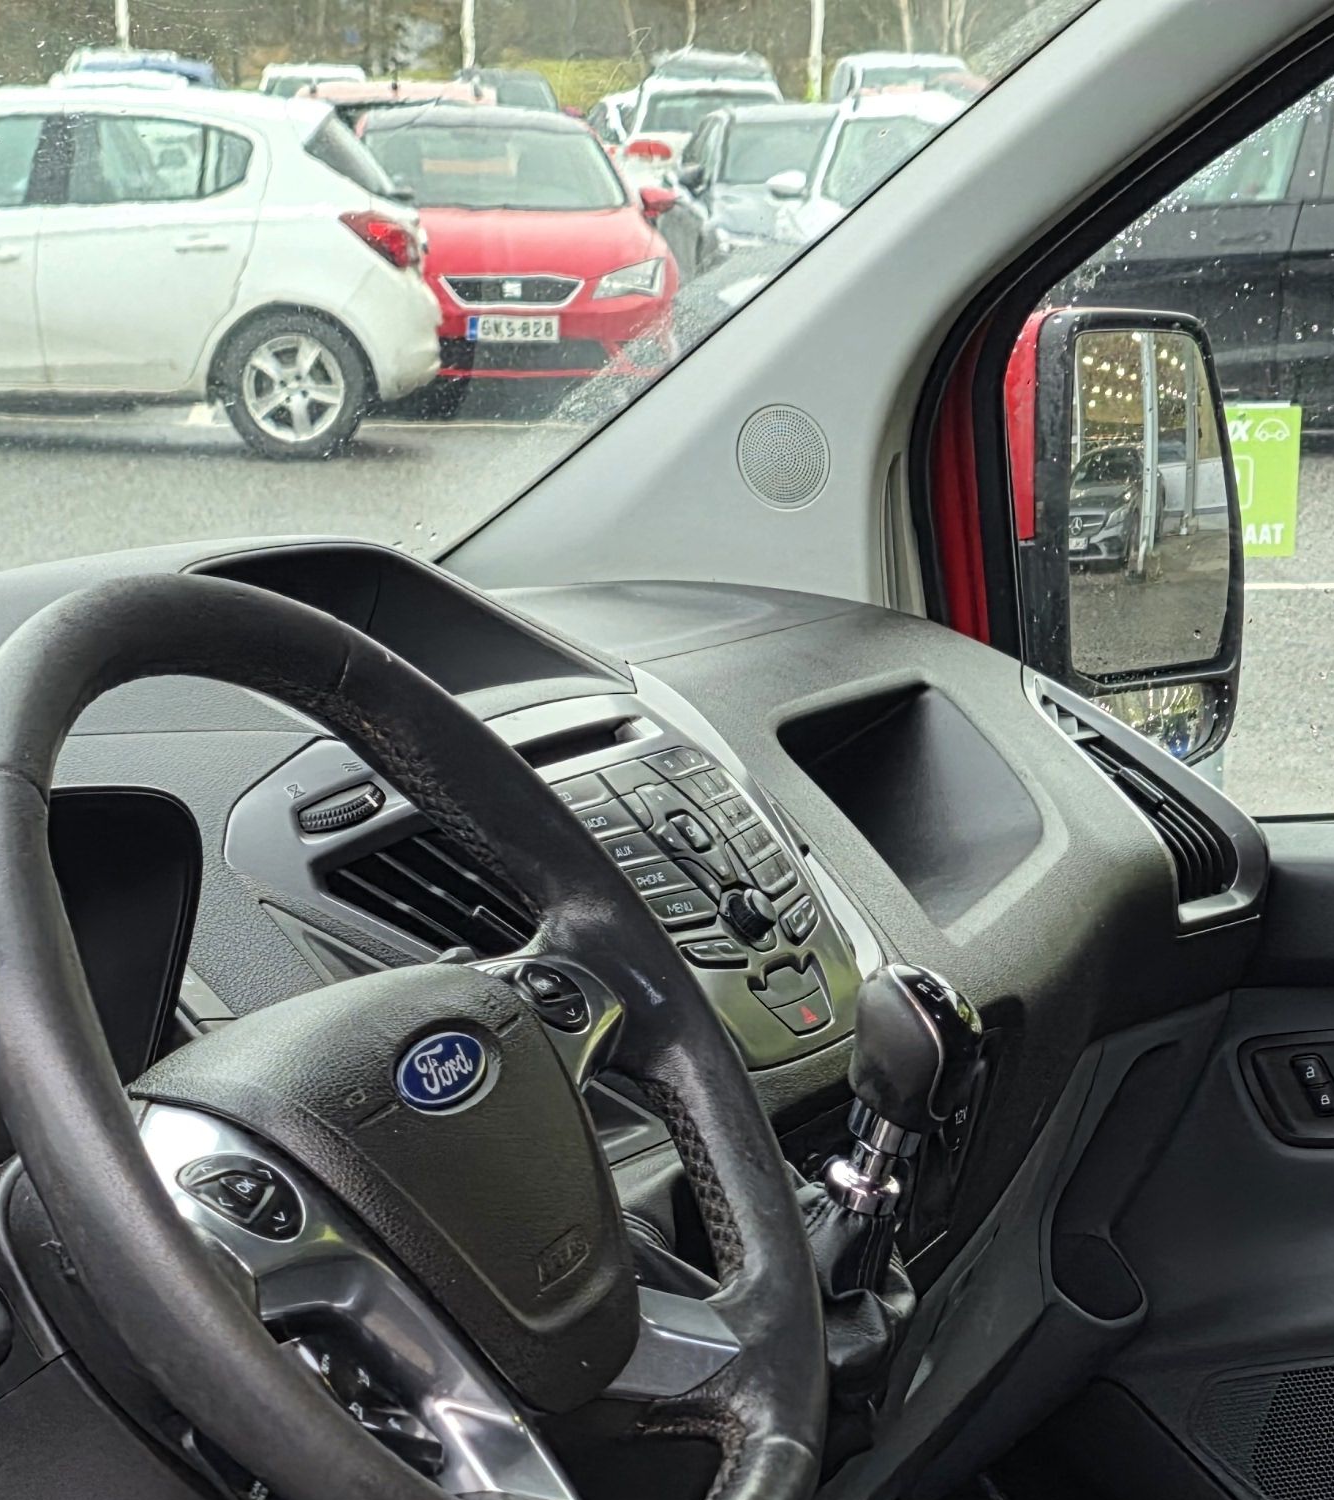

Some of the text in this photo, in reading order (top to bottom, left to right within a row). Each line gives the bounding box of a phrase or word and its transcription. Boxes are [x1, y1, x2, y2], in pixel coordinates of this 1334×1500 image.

[1243, 522, 1285, 545] AAT
[615, 845, 633, 858] AUX
[635, 871, 666, 887] PHONE
[666, 901, 693, 915] MENU
[413, 1042, 474, 1095] Ford
[235, 1178, 257, 1194] OK
